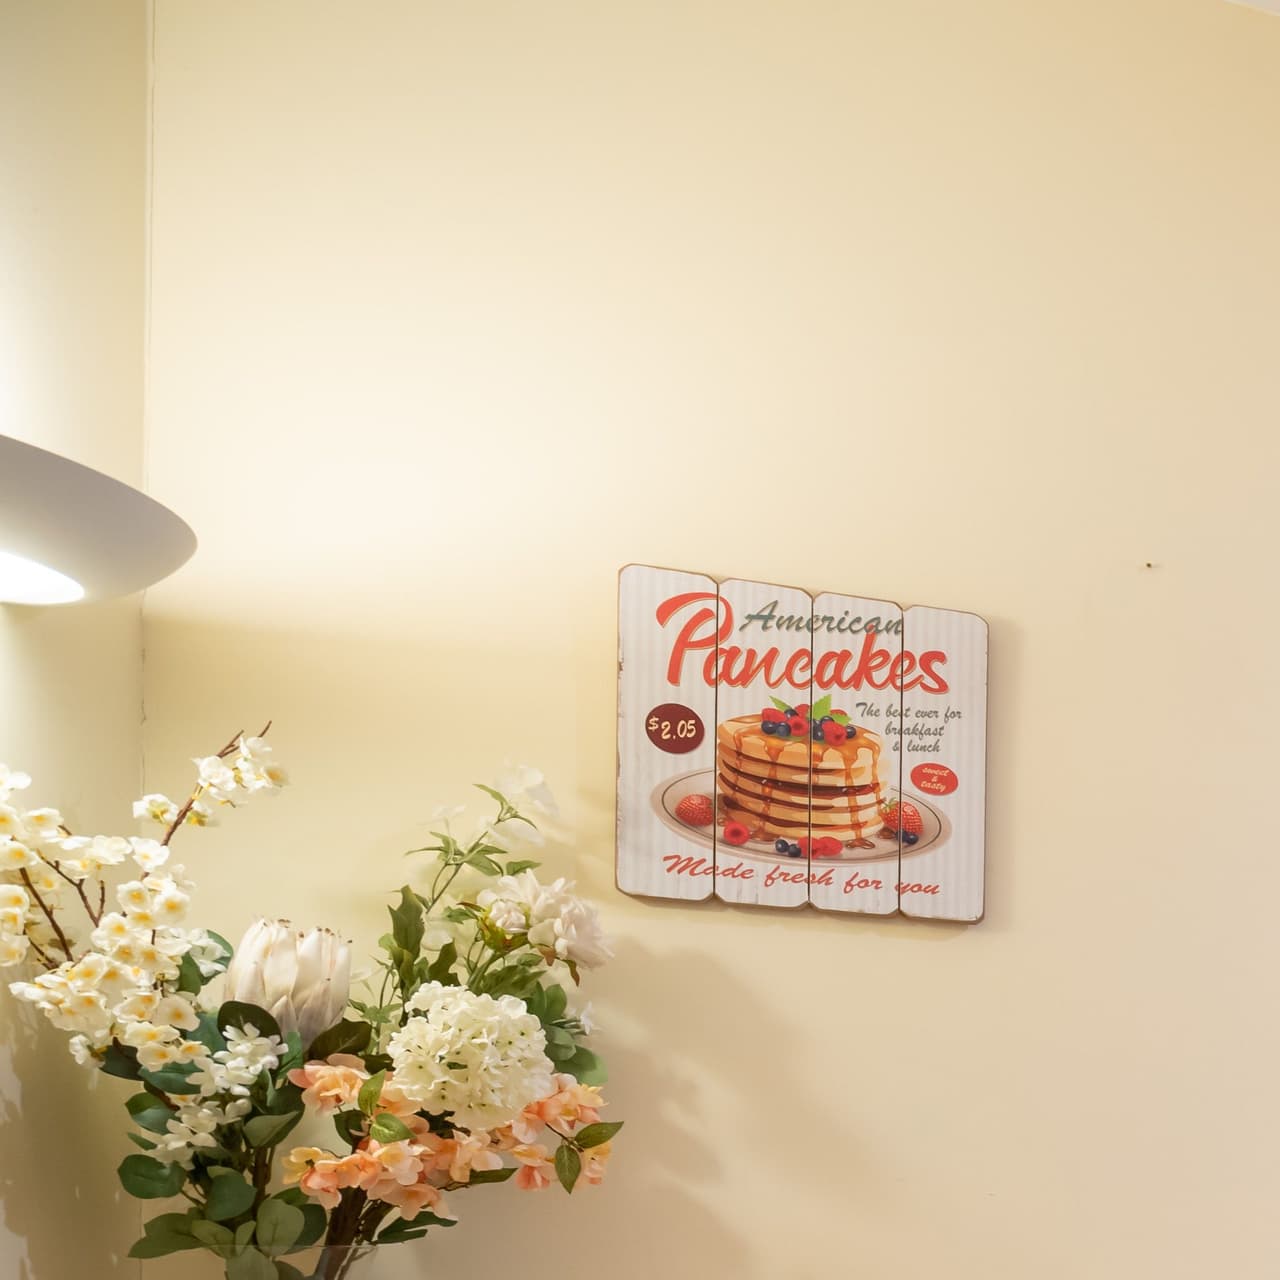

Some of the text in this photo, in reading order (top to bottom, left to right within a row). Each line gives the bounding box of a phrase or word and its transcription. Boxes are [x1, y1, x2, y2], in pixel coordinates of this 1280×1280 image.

[739, 600, 902, 636] American
[656, 592, 949, 695] Pancakes
[856, 702, 963, 724] The best ever for
[648, 715, 696, 740] $2.05
[885, 721, 945, 741] breakfast
[907, 739, 941, 752] lunch
[663, 854, 940, 895] Made fresh for you
